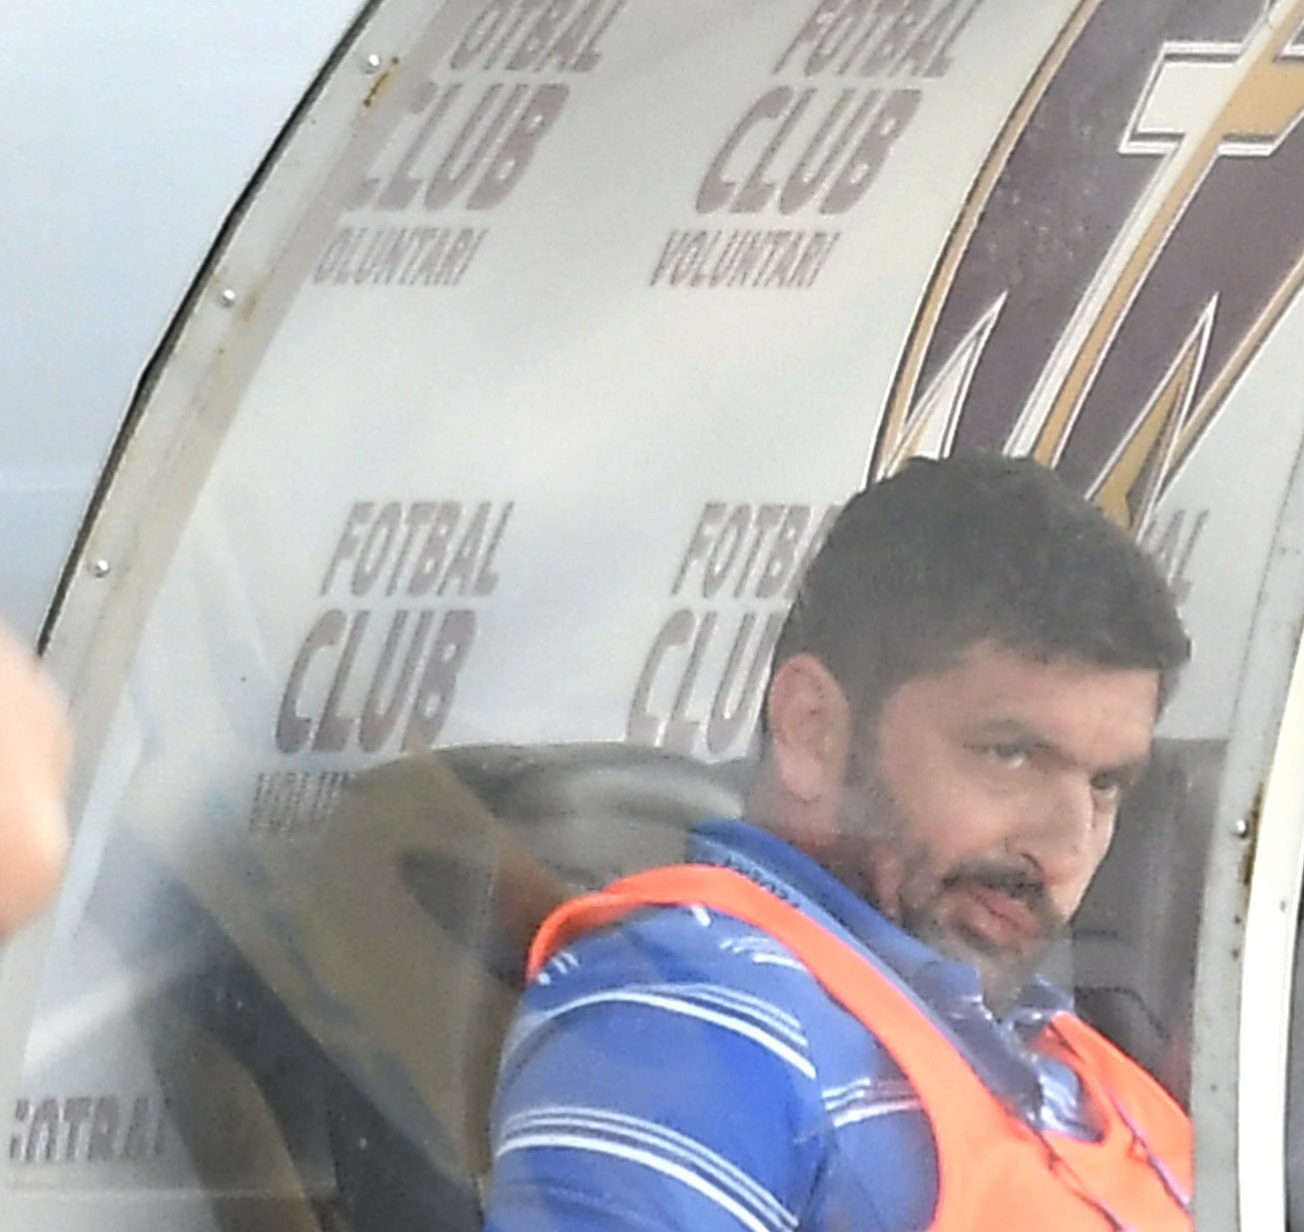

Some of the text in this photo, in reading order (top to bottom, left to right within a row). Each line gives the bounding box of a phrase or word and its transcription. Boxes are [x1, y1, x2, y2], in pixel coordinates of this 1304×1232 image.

[695, 85, 922, 215] CLUB
[649, 230, 841, 287] VOLUNTARI
[319, 500, 514, 597] FOTBAL
[276, 609, 478, 753] CLUB
[627, 608, 790, 753] CLU
